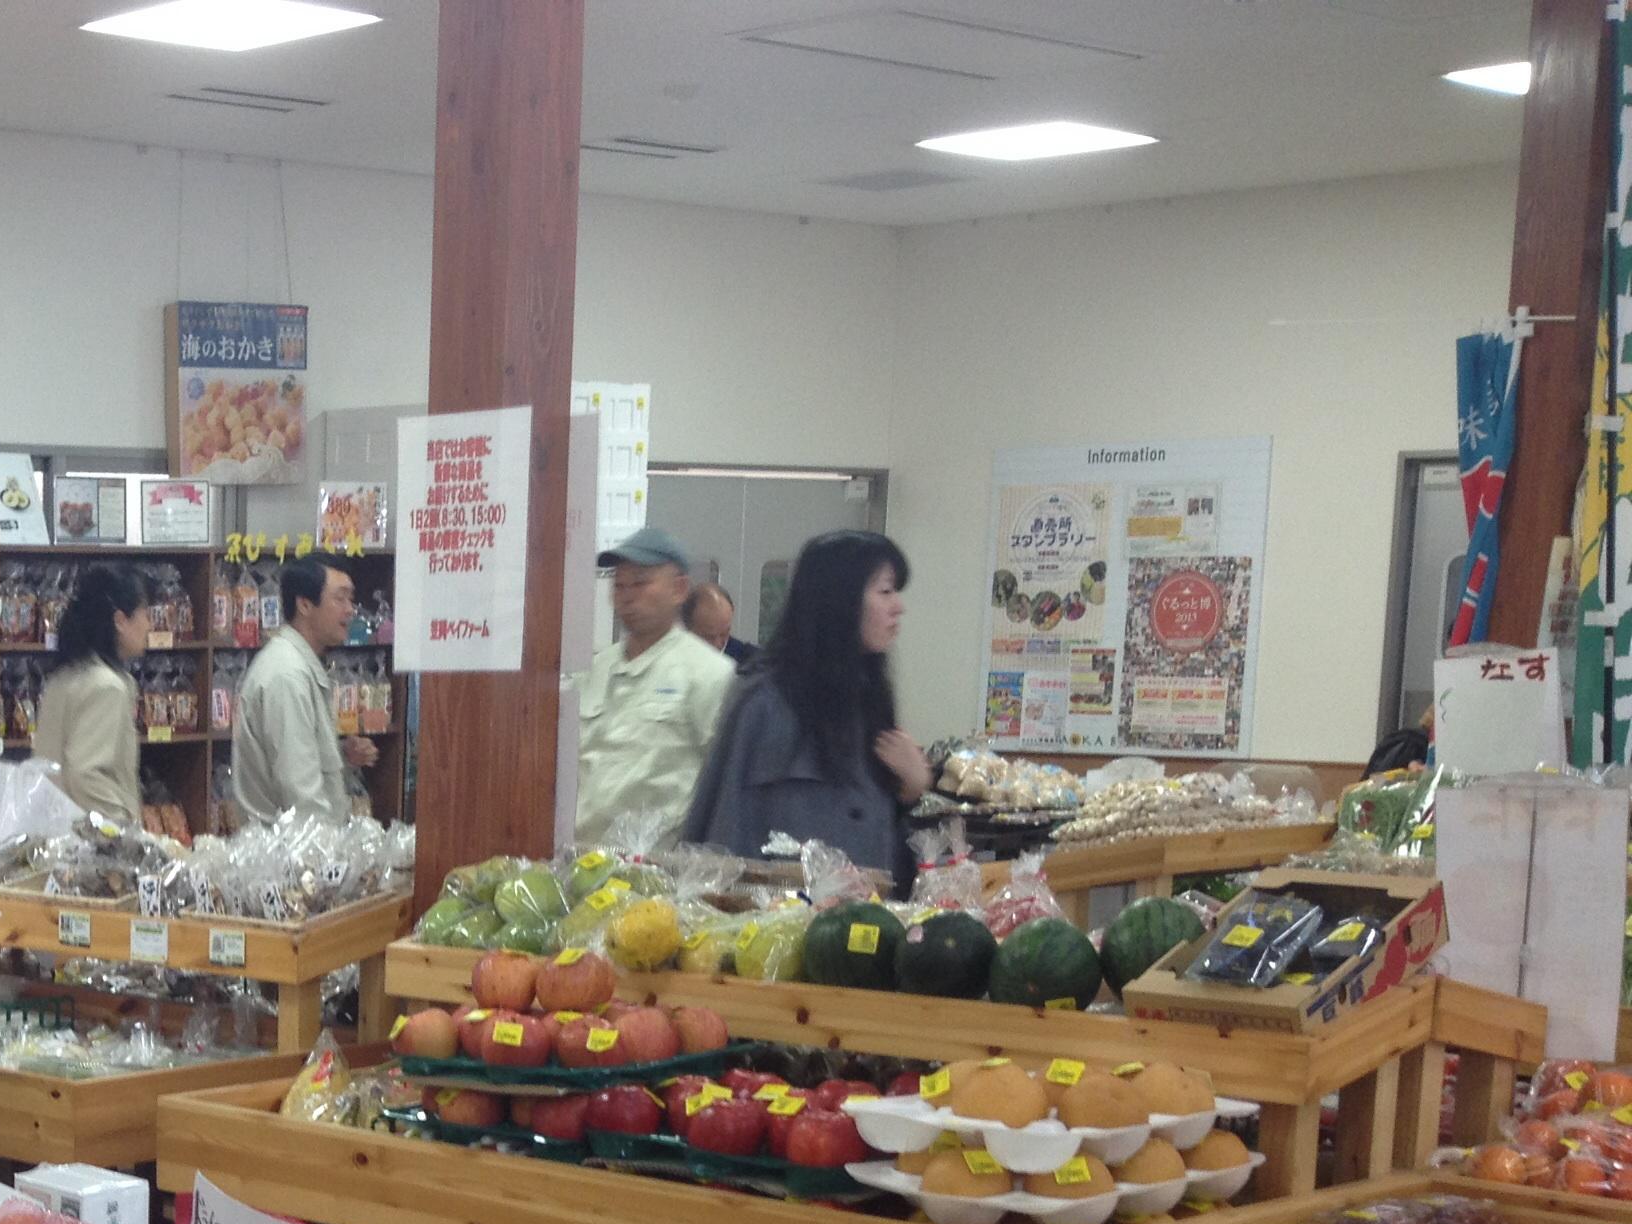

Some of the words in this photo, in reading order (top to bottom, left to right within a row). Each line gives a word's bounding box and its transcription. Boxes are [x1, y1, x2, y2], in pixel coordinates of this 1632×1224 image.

[181, 334, 273, 361] 海のおかき
[1087, 446, 1166, 464] Information
[1011, 533, 1097, 548] スタンプラリー
